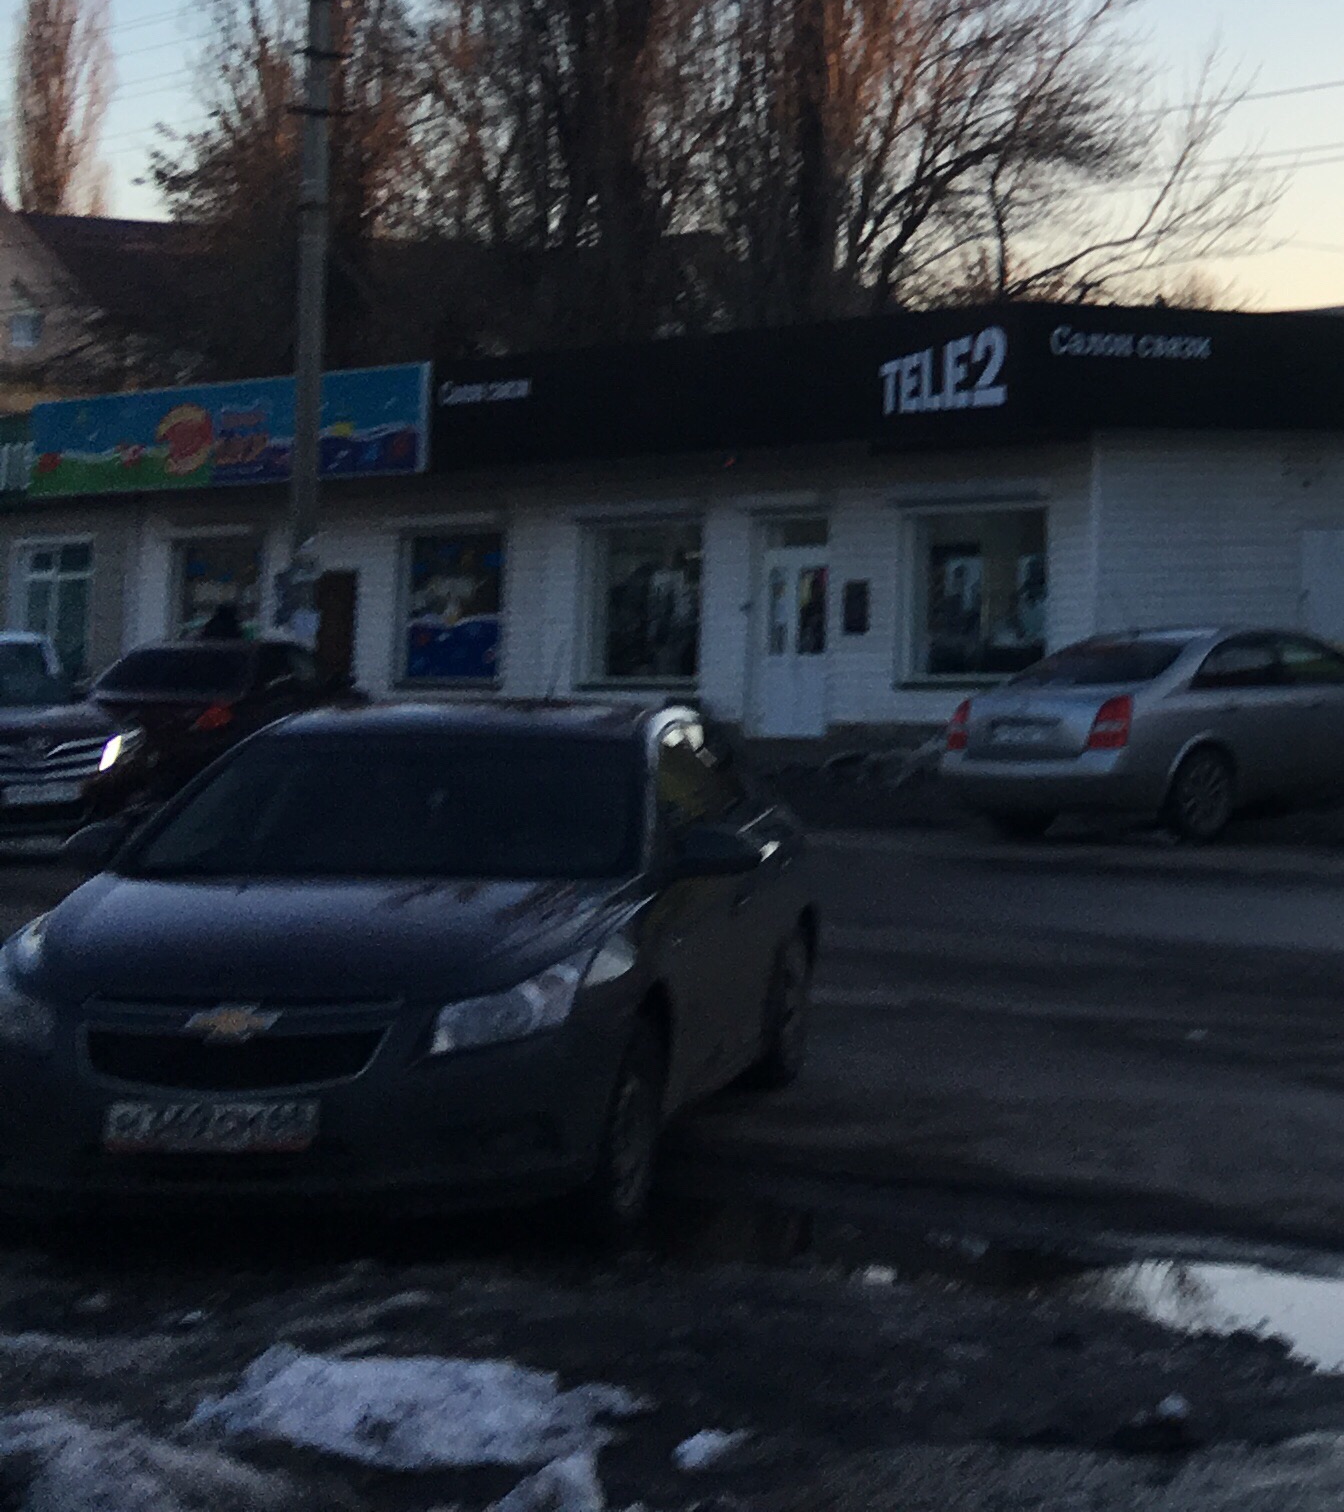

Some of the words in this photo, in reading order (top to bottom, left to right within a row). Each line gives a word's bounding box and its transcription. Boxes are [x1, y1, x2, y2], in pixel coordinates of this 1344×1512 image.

[878, 326, 1009, 414] TELE2
[1051, 324, 1134, 358] Салон
[1137, 333, 1212, 360] связи
